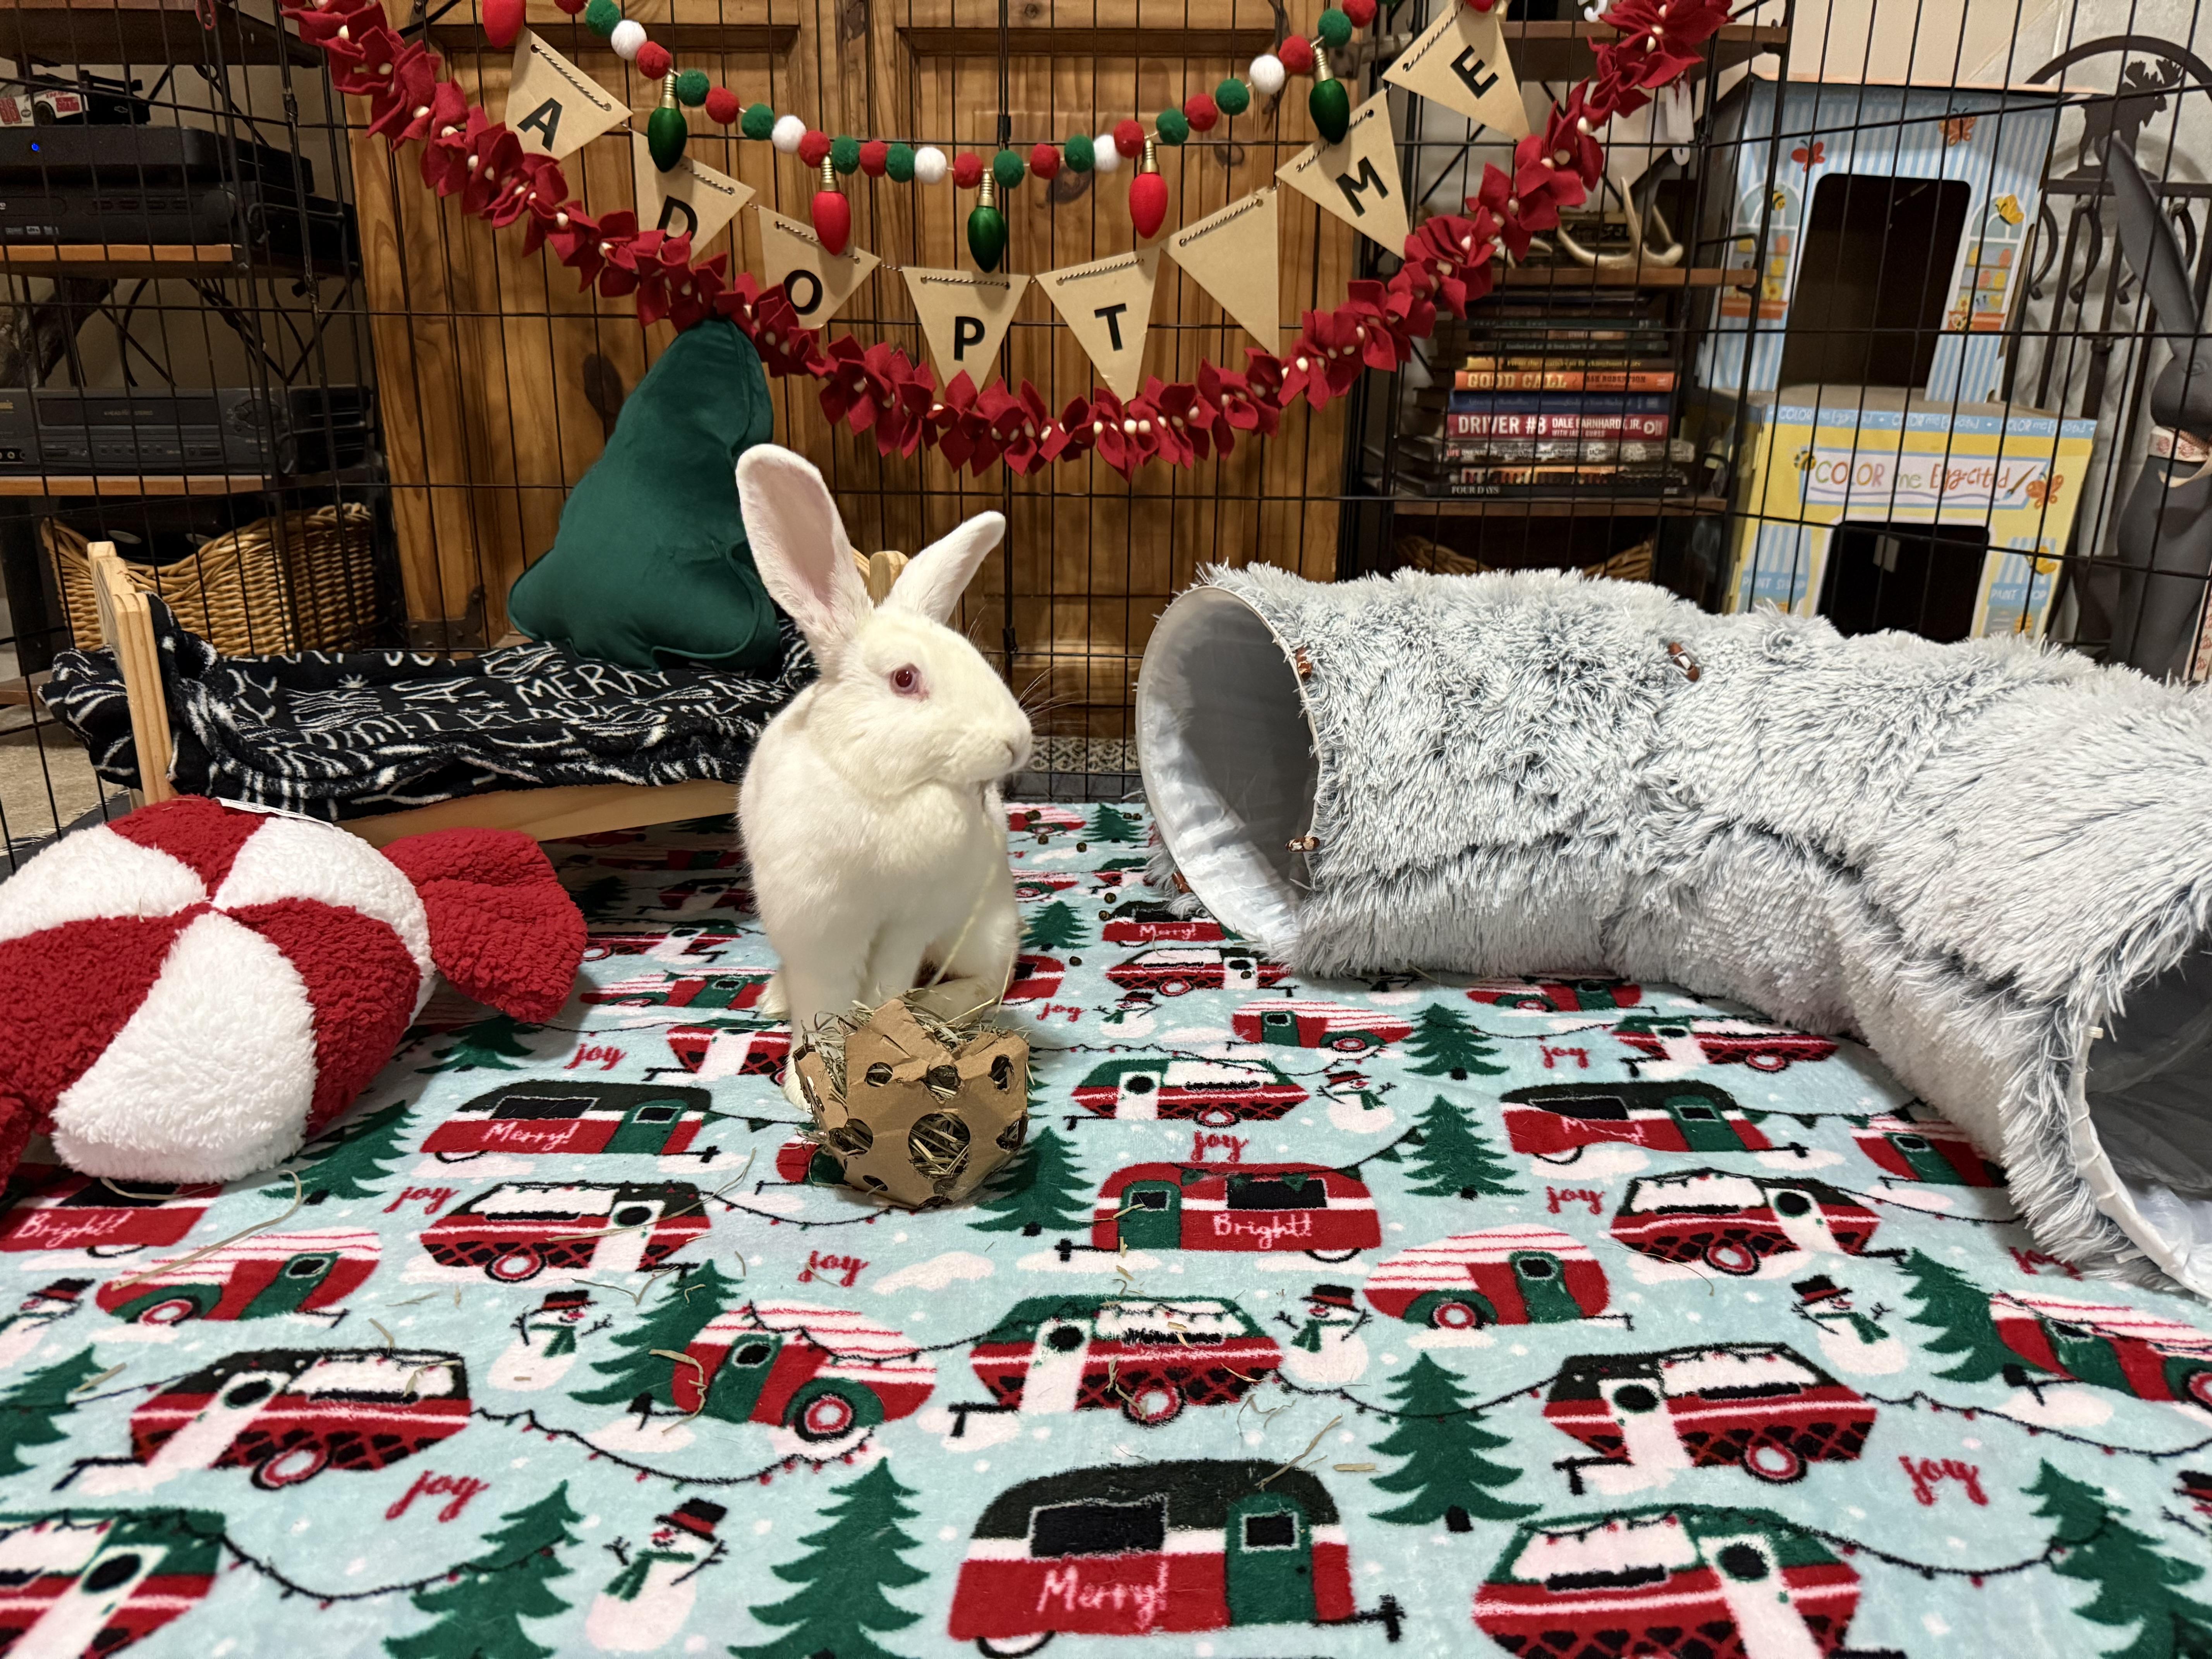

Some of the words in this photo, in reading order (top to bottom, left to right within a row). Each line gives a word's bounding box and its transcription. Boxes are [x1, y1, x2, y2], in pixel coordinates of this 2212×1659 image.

[1522, 373, 1567, 389] CALL
[1458, 416, 1520, 434] DRIVER
[1526, 416, 1546, 435] #8
[1552, 418, 1573, 429] DALE
[1815, 460, 1886, 487] COOR
[1451, 486, 1475, 495] FOUR
[563, 1042, 628, 1071] joy
[1540, 1044, 1590, 1069] joy
[481, 1121, 581, 1151] Merry!
[1190, 1130, 1250, 1162] joy
[382, 1186, 461, 1215] joy
[1545, 1185, 1606, 1215] joy
[12, 1210, 134, 1249] Bright!
[1212, 1213, 1313, 1249] Bright!
[797, 1250, 871, 1287] joy
[1898, 1455, 1989, 1506] joy
[385, 1470, 490, 1522] joy
[1036, 1560, 1170, 1630] Merry!
